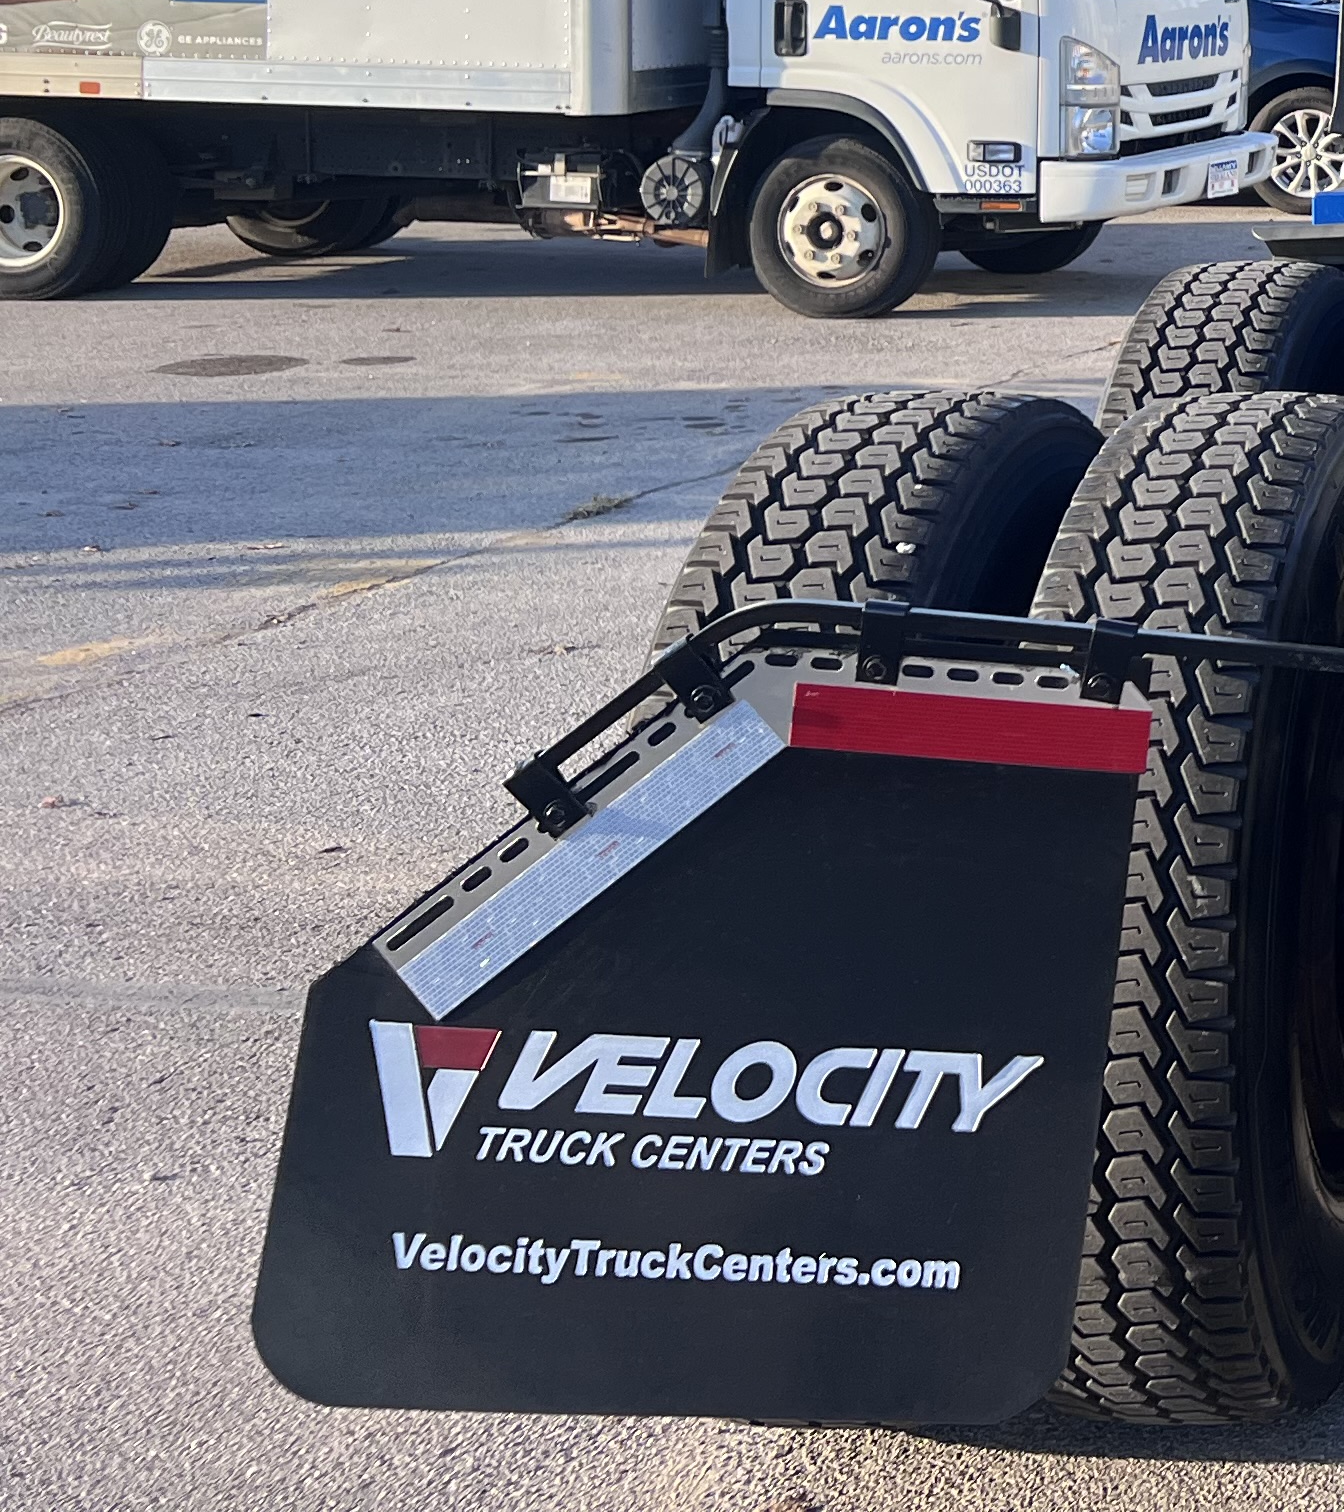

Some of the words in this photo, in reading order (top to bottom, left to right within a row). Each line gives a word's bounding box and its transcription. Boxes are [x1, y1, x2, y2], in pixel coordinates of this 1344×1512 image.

[32, 24, 111, 45] Beautyrest
[812, 5, 982, 42] Aaron's
[177, 35, 192, 44] GE
[195, 36, 263, 46] APPLIANCES
[1137, 14, 1229, 64] Aaron's
[881, 51, 982, 65] aarons.com
[965, 164, 1025, 178] USDOT
[964, 179, 1022, 193] 000363
[498, 1029, 1045, 1133] VELOCITY
[474, 1125, 623, 1168] TRUCK
[630, 1133, 831, 1176] CENTERS
[391, 1231, 961, 1290] VelocityTruckCenters.com
